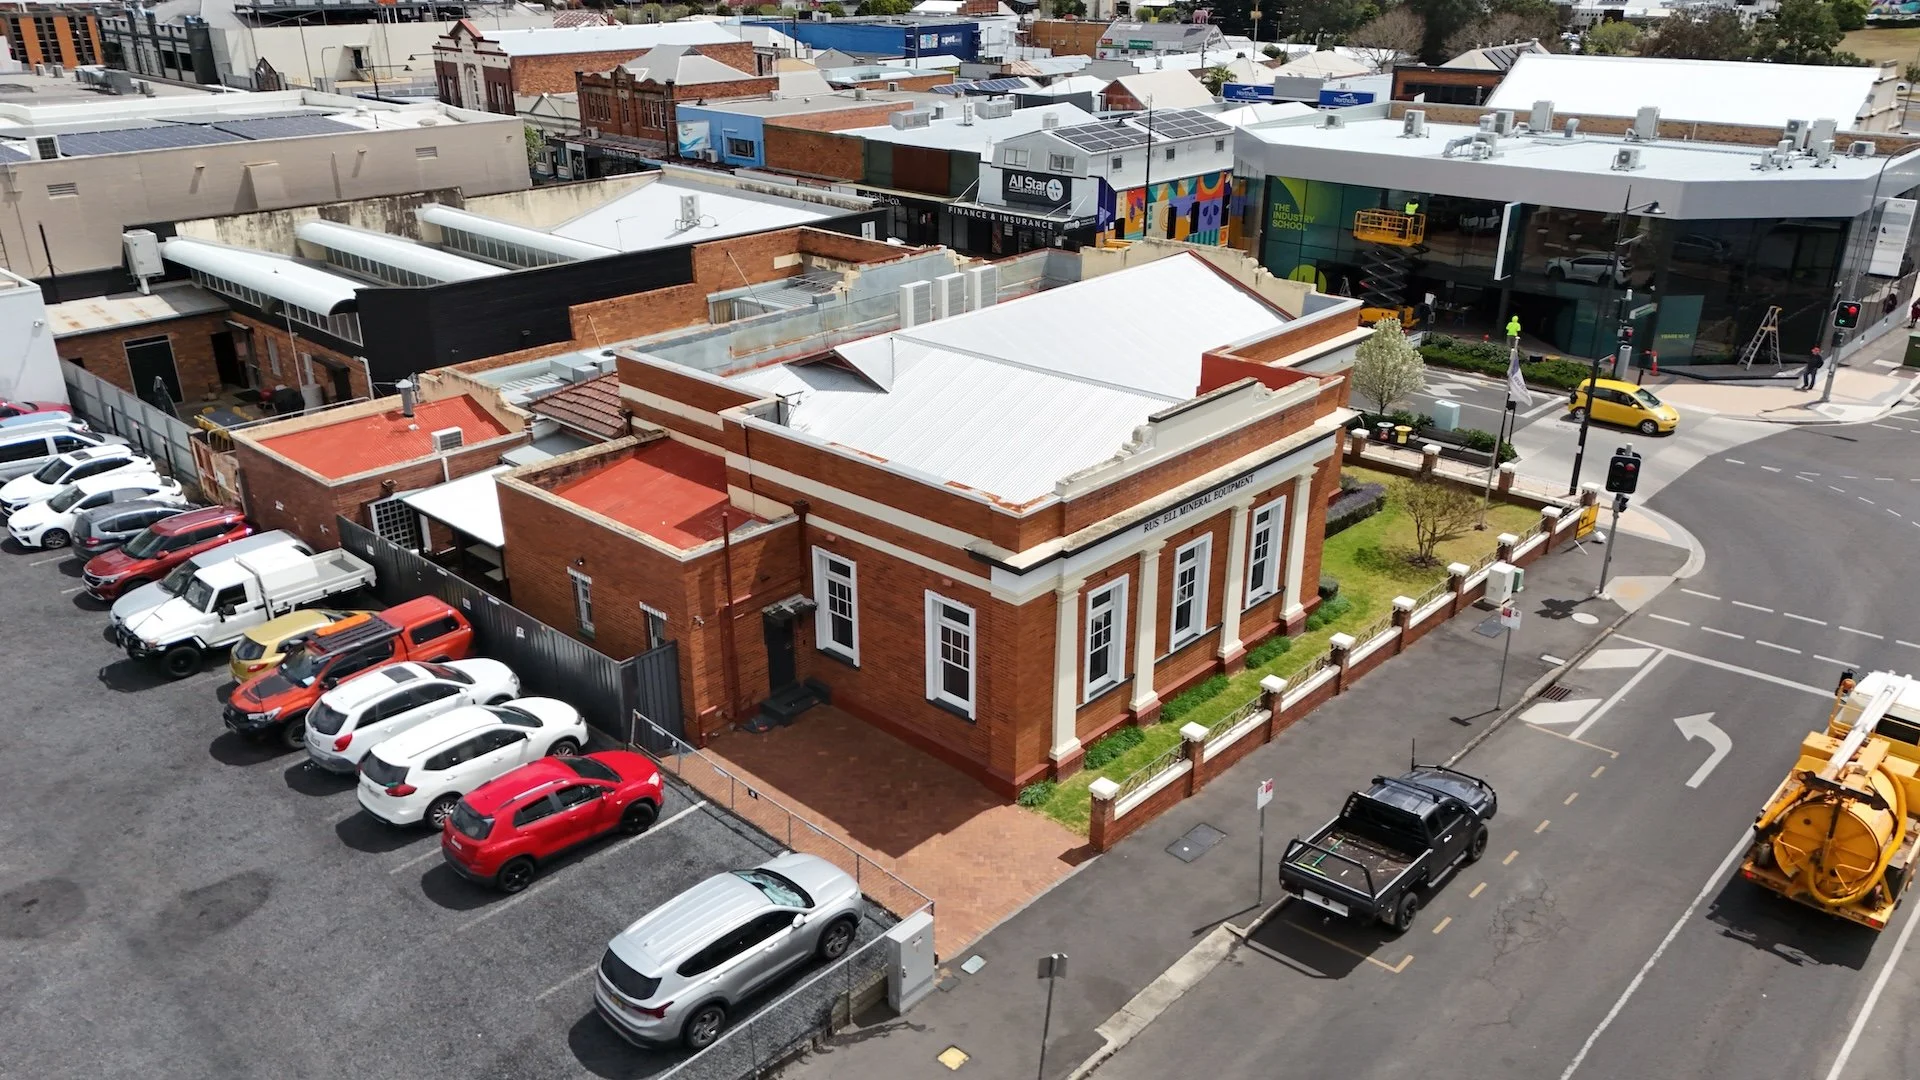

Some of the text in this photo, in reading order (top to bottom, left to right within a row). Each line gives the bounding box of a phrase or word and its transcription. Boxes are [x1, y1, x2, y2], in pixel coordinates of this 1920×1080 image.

[1009, 173, 1047, 191] All Star
[1020, 188, 1047, 197] BROKERS
[1274, 203, 1290, 212] THE
[948, 206, 986, 219] FINANCE
[990, 212, 996, 221] &
[1000, 214, 1053, 230] INSURANCE
[1273, 212, 1315, 223] INDUSTRY
[1272, 220, 1307, 231] SCHOOL
[1143, 474, 1254, 533] RUSELL MINERAL EQUIPMENT
